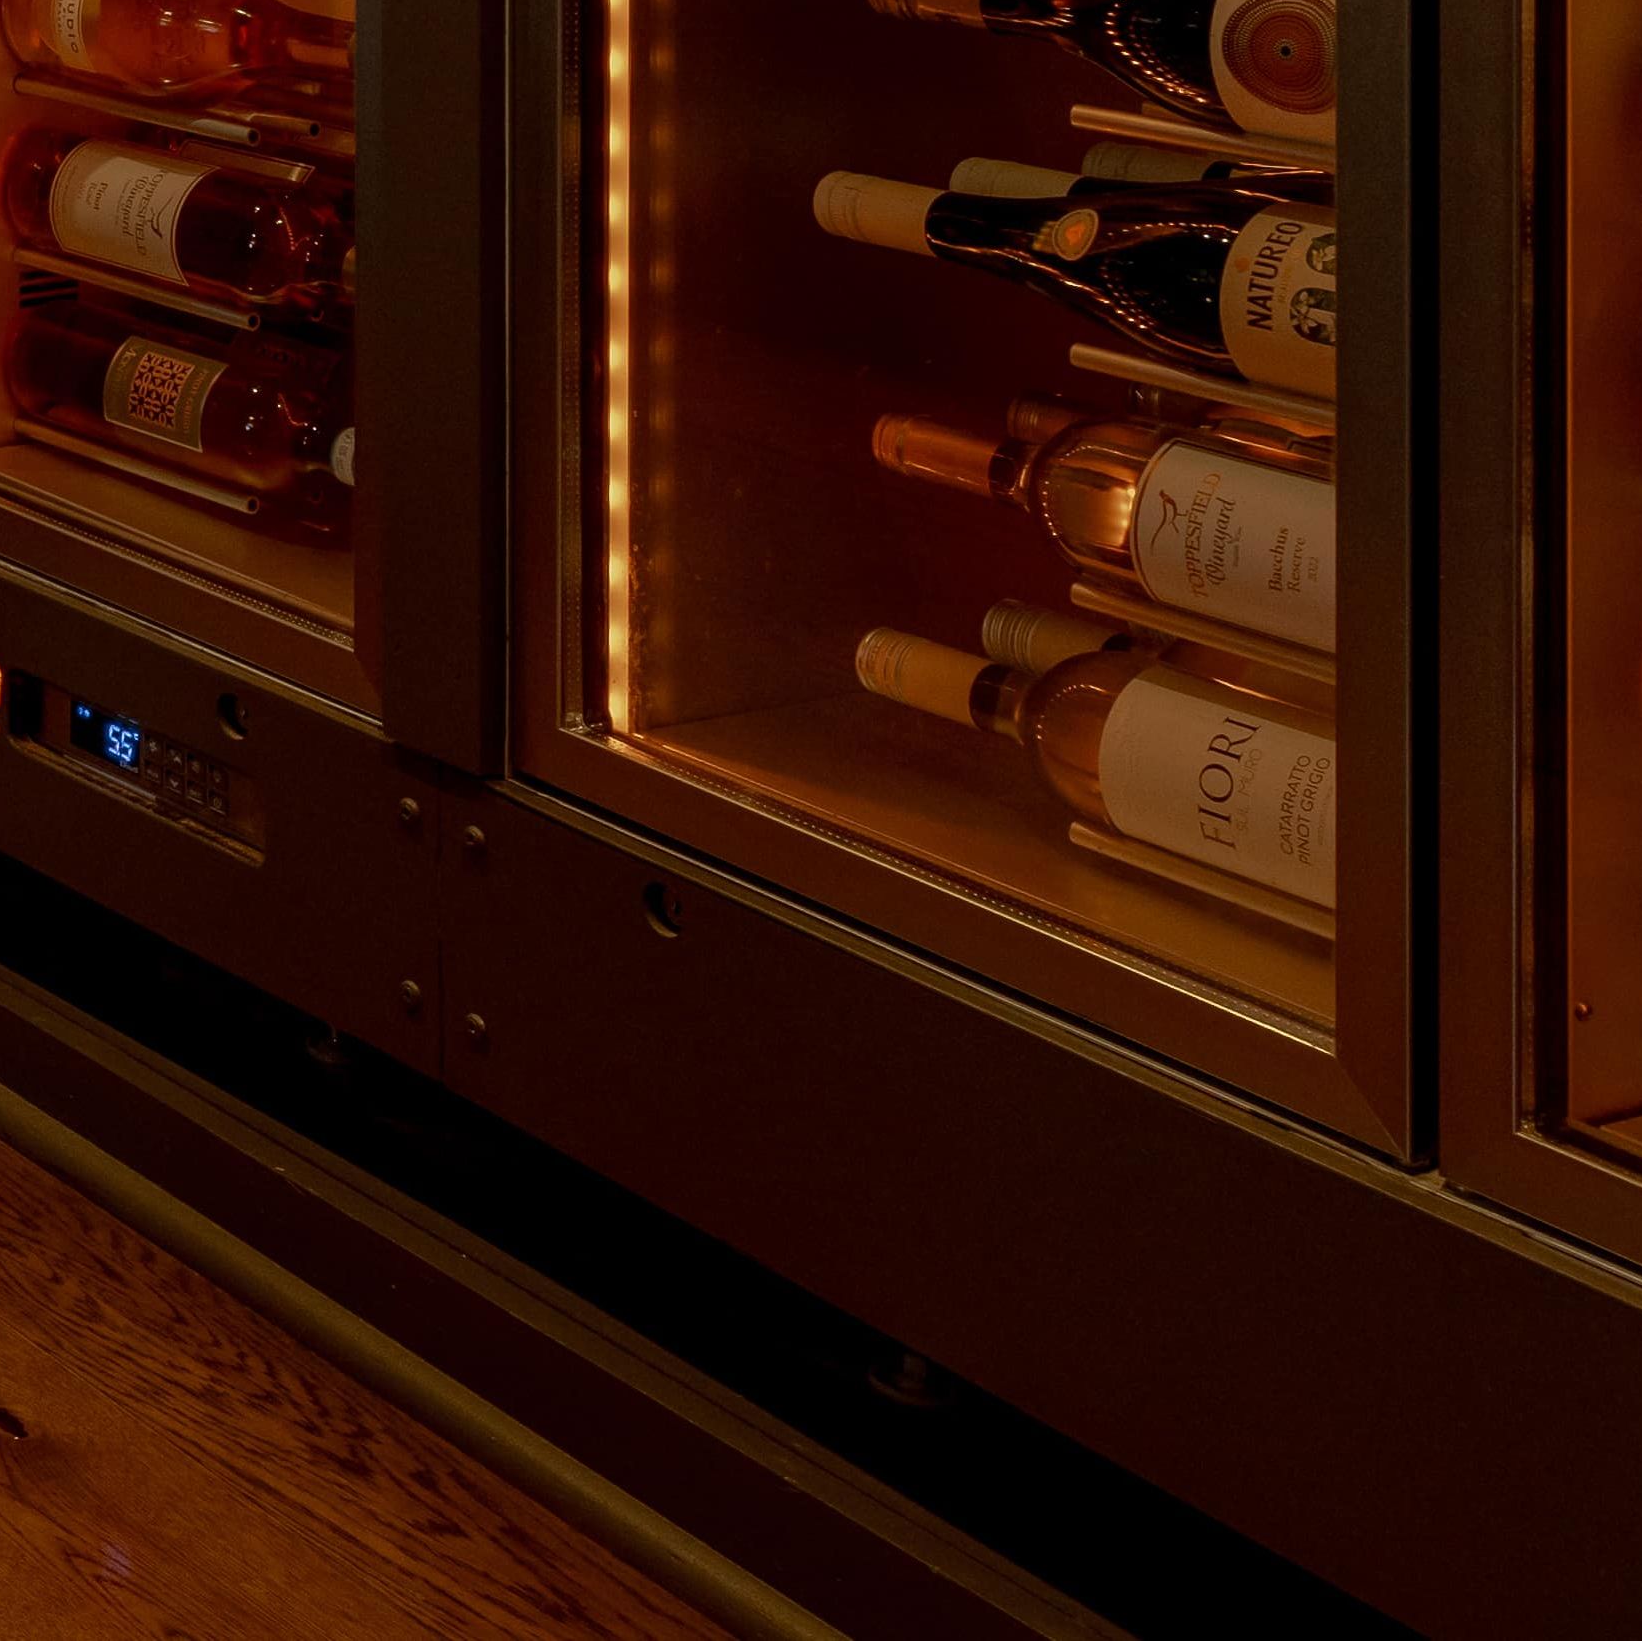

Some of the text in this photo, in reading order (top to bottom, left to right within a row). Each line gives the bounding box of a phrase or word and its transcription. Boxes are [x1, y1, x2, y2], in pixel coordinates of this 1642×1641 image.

[1246, 222, 1304, 332] NATUREO
[1183, 472, 1221, 598] TOPPESFIELD
[1267, 527, 1290, 592] Bacchus
[1286, 536, 1307, 593] Reserve
[1197, 717, 1262, 850] FIORI
[1278, 755, 1311, 855] CATARRATTO
[1299, 757, 1331, 812] GRIGIO
[1296, 814, 1312, 865] PINOT
